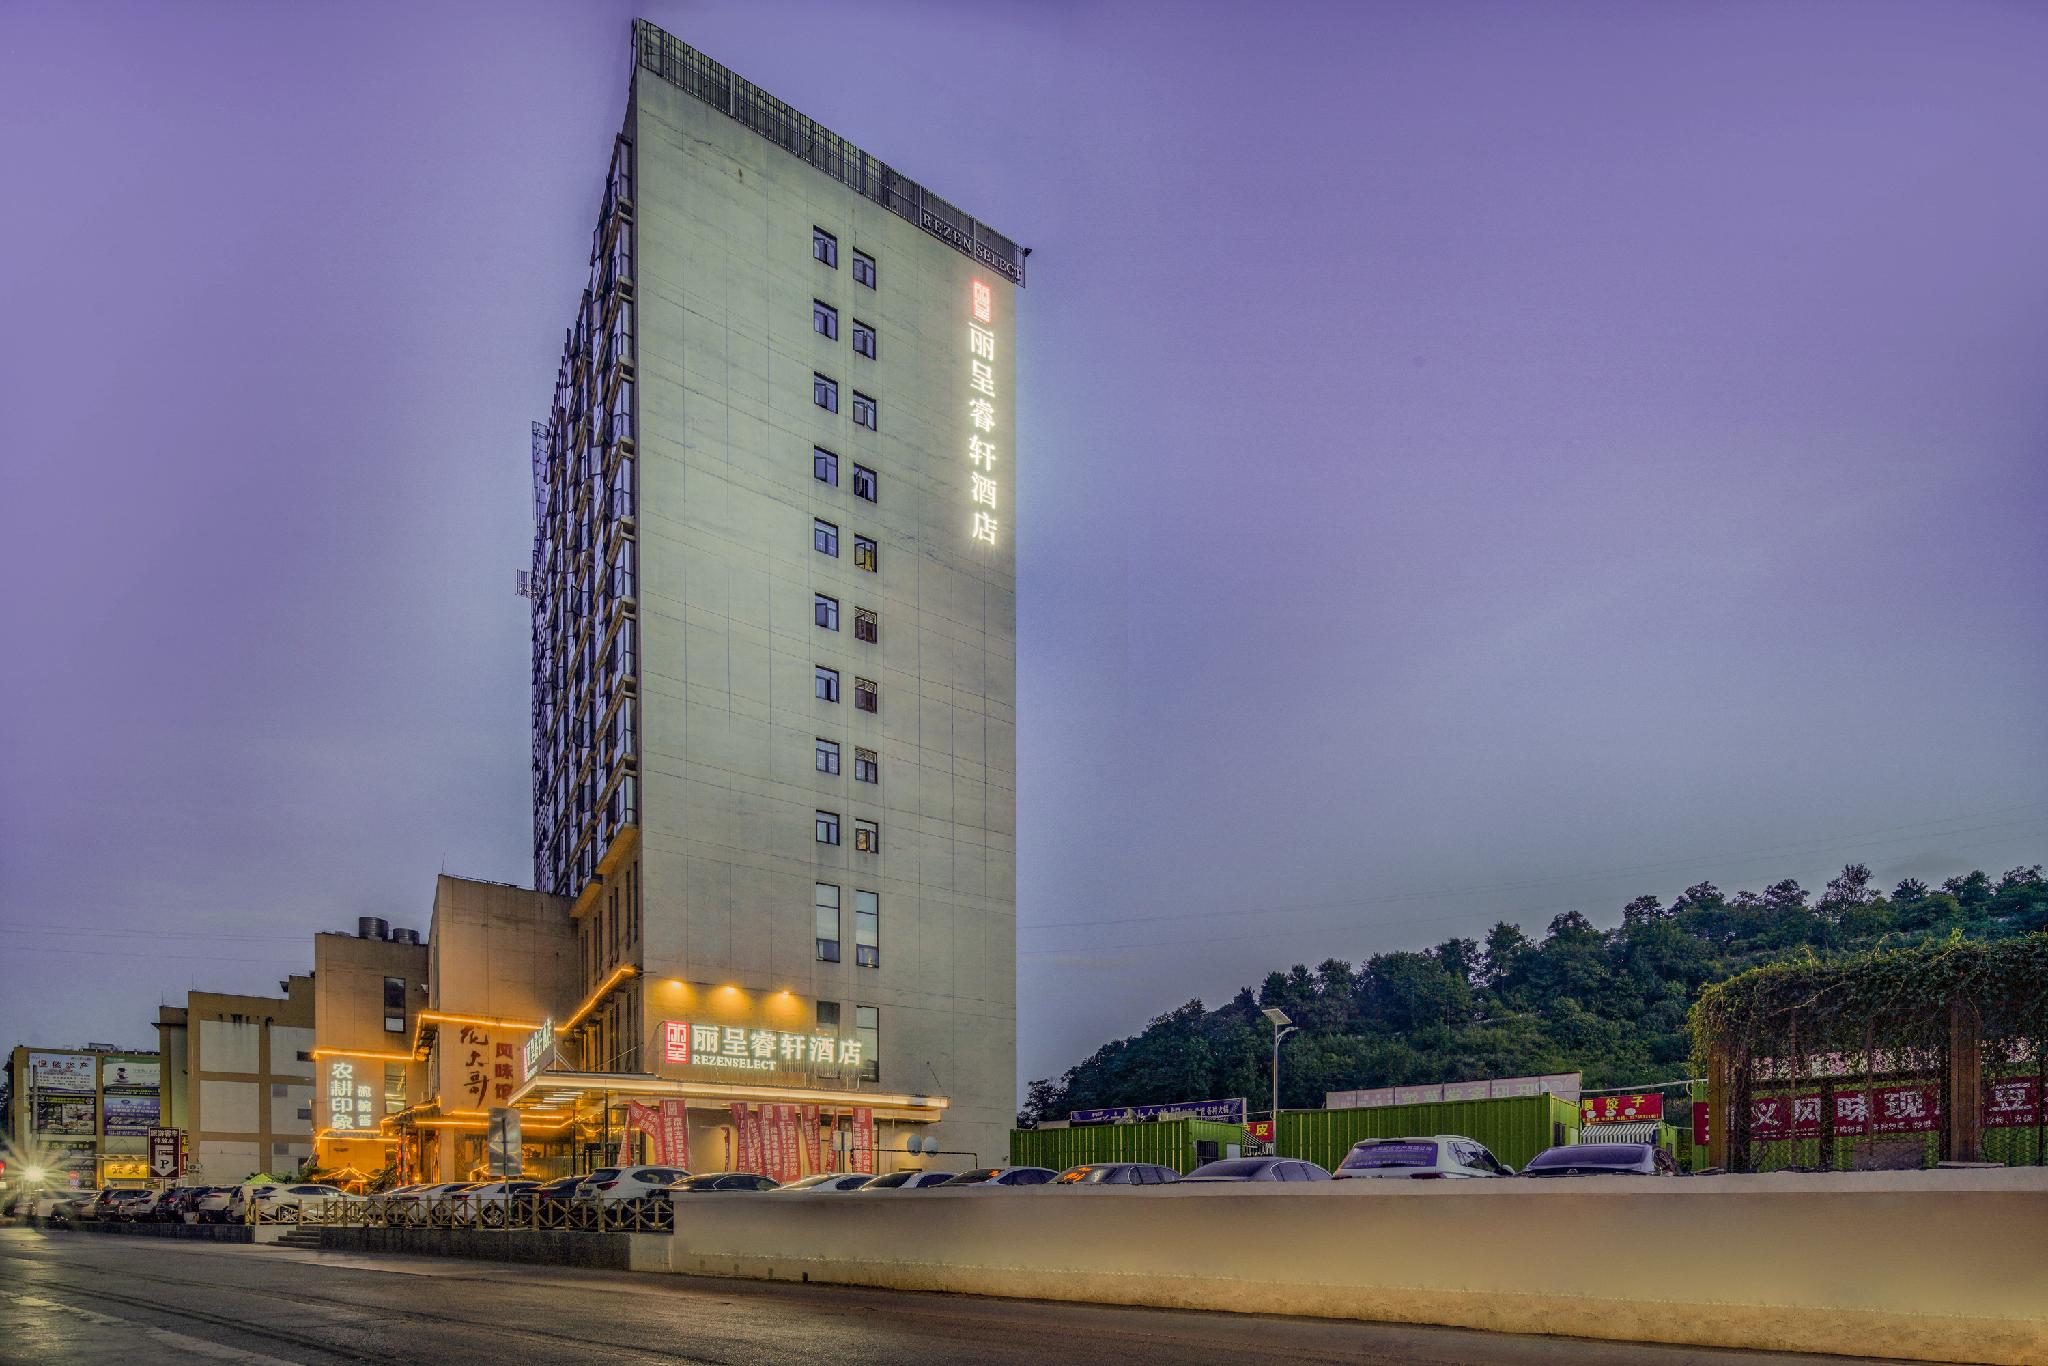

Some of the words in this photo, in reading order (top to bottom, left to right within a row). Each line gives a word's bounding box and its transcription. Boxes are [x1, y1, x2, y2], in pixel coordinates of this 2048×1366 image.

[922, 211, 972, 252] REZEN
[976, 243, 1022, 280] SELECT
[968, 322, 998, 546] 丽呈睿轩酒店
[691, 1024, 862, 1066] 丽呈睿轩酒店
[692, 1055, 776, 1070] REZENSELECT
[331, 1062, 354, 1130] 农耕印象
[160, 1160, 170, 1169] P
